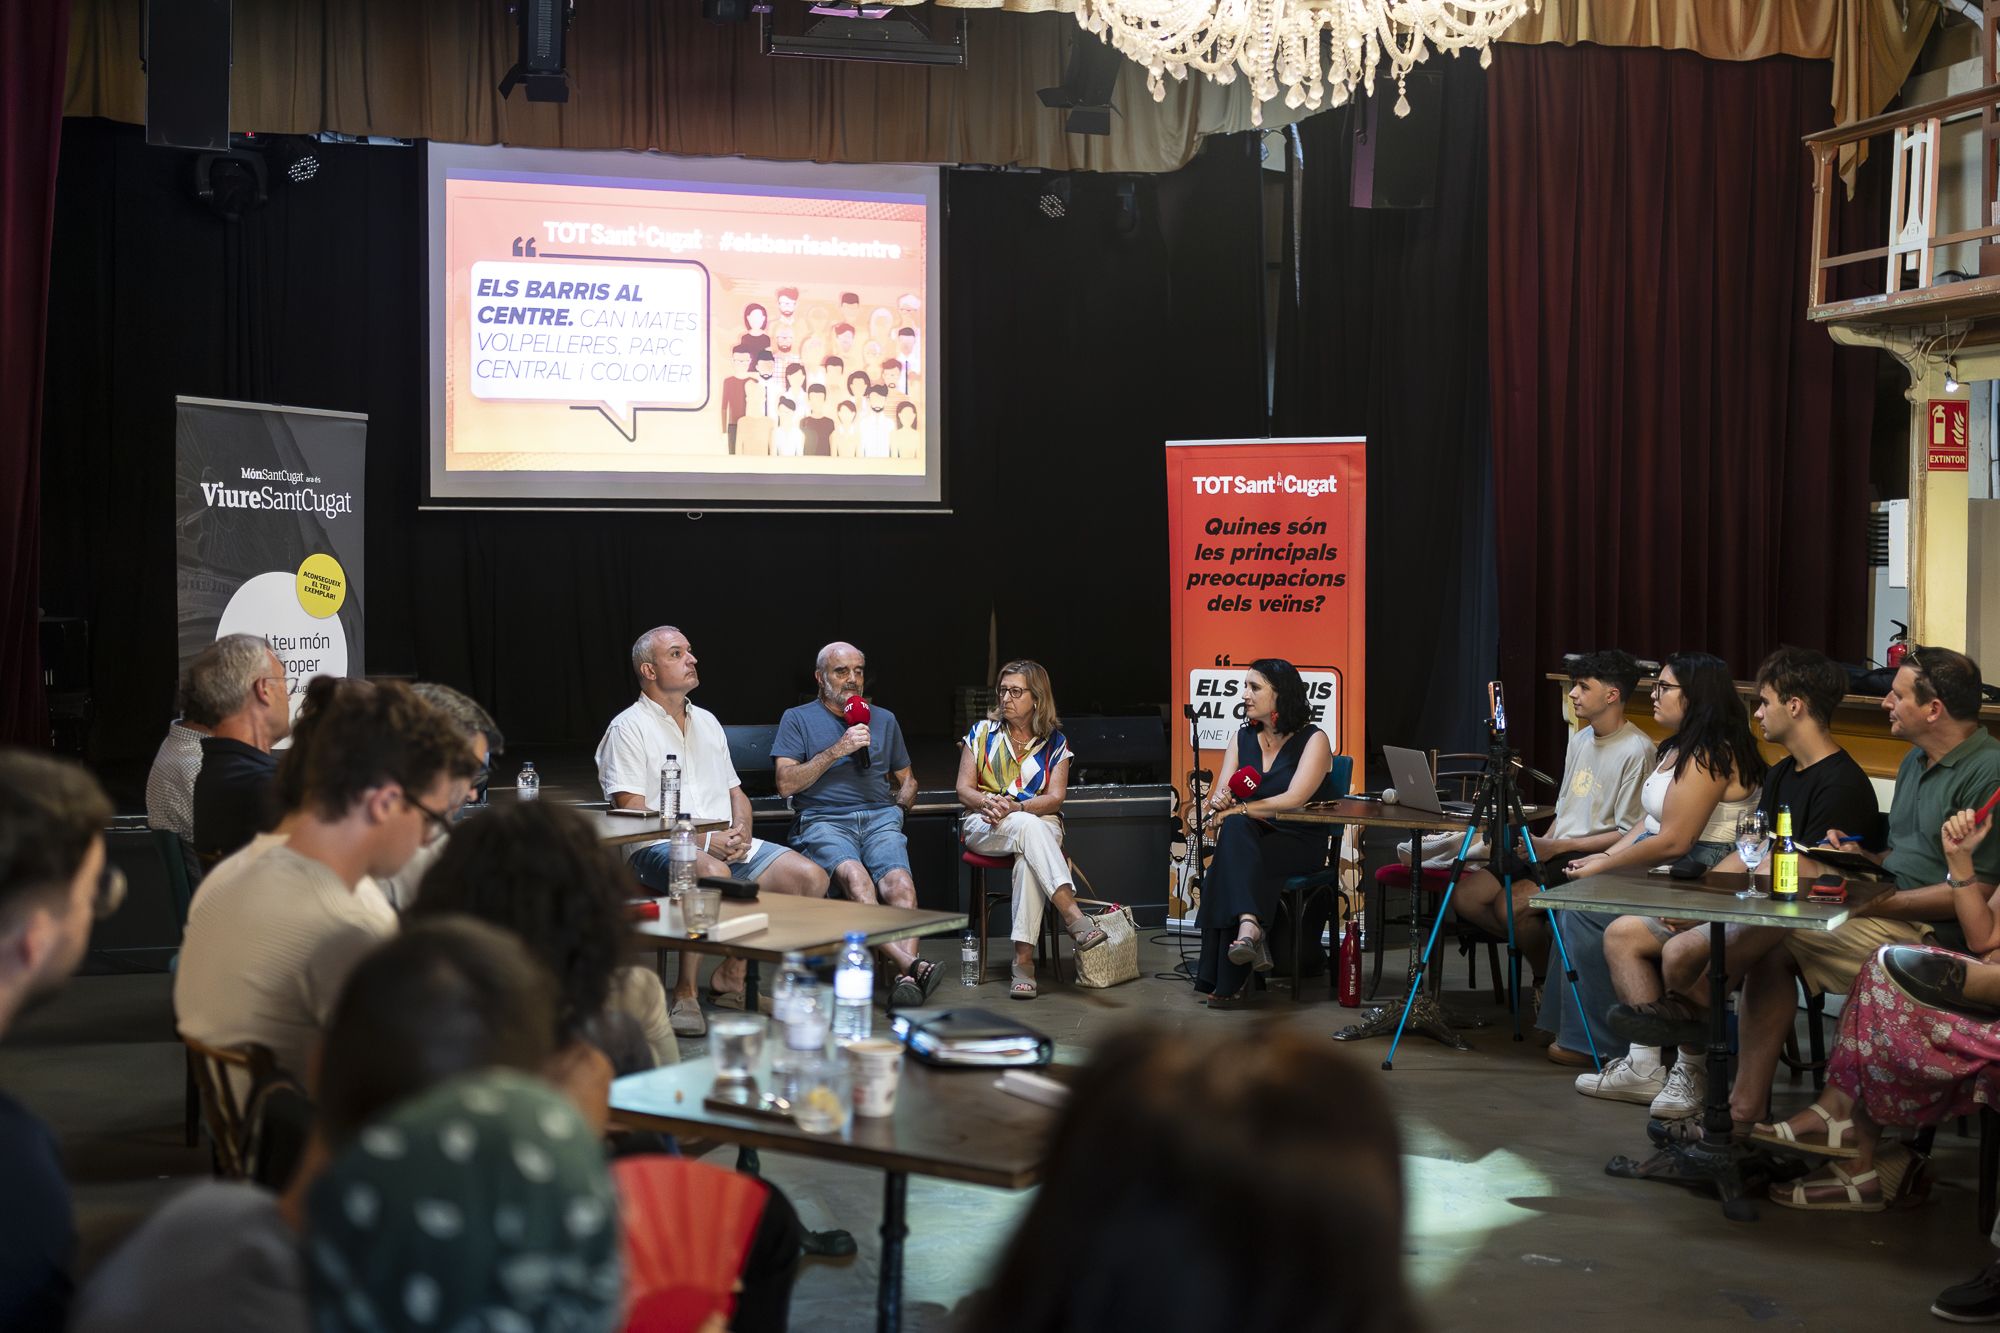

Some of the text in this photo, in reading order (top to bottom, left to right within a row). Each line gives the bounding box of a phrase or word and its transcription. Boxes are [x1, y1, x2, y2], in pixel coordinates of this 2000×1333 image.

[477, 278, 644, 302] ELS BARRIS AL
[477, 305, 699, 331] CENTRE. CAN MATES
[628, 336, 685, 357] PARC
[476, 358, 572, 380] CENTRAL
[590, 362, 693, 383] COLOMER
[1929, 454, 1966, 463] EXTINTOR
[1204, 516, 1327, 536] Quines són
[1194, 542, 1338, 565] les principals
[303, 571, 341, 588] ACONSEGUEIX
[312, 580, 331, 591] EL TEU
[1186, 568, 1346, 590] preocupacions
[304, 585, 336, 601] EXEMPLAR!
[1207, 594, 1326, 613] dels veïns?
[272, 635, 296, 651] teu
[299, 632, 330, 650] món
[283, 658, 321, 677] roper
[1196, 679, 1239, 697] ELS
[1198, 701, 1225, 719] AL
[1243, 775, 1257, 790] TOT
